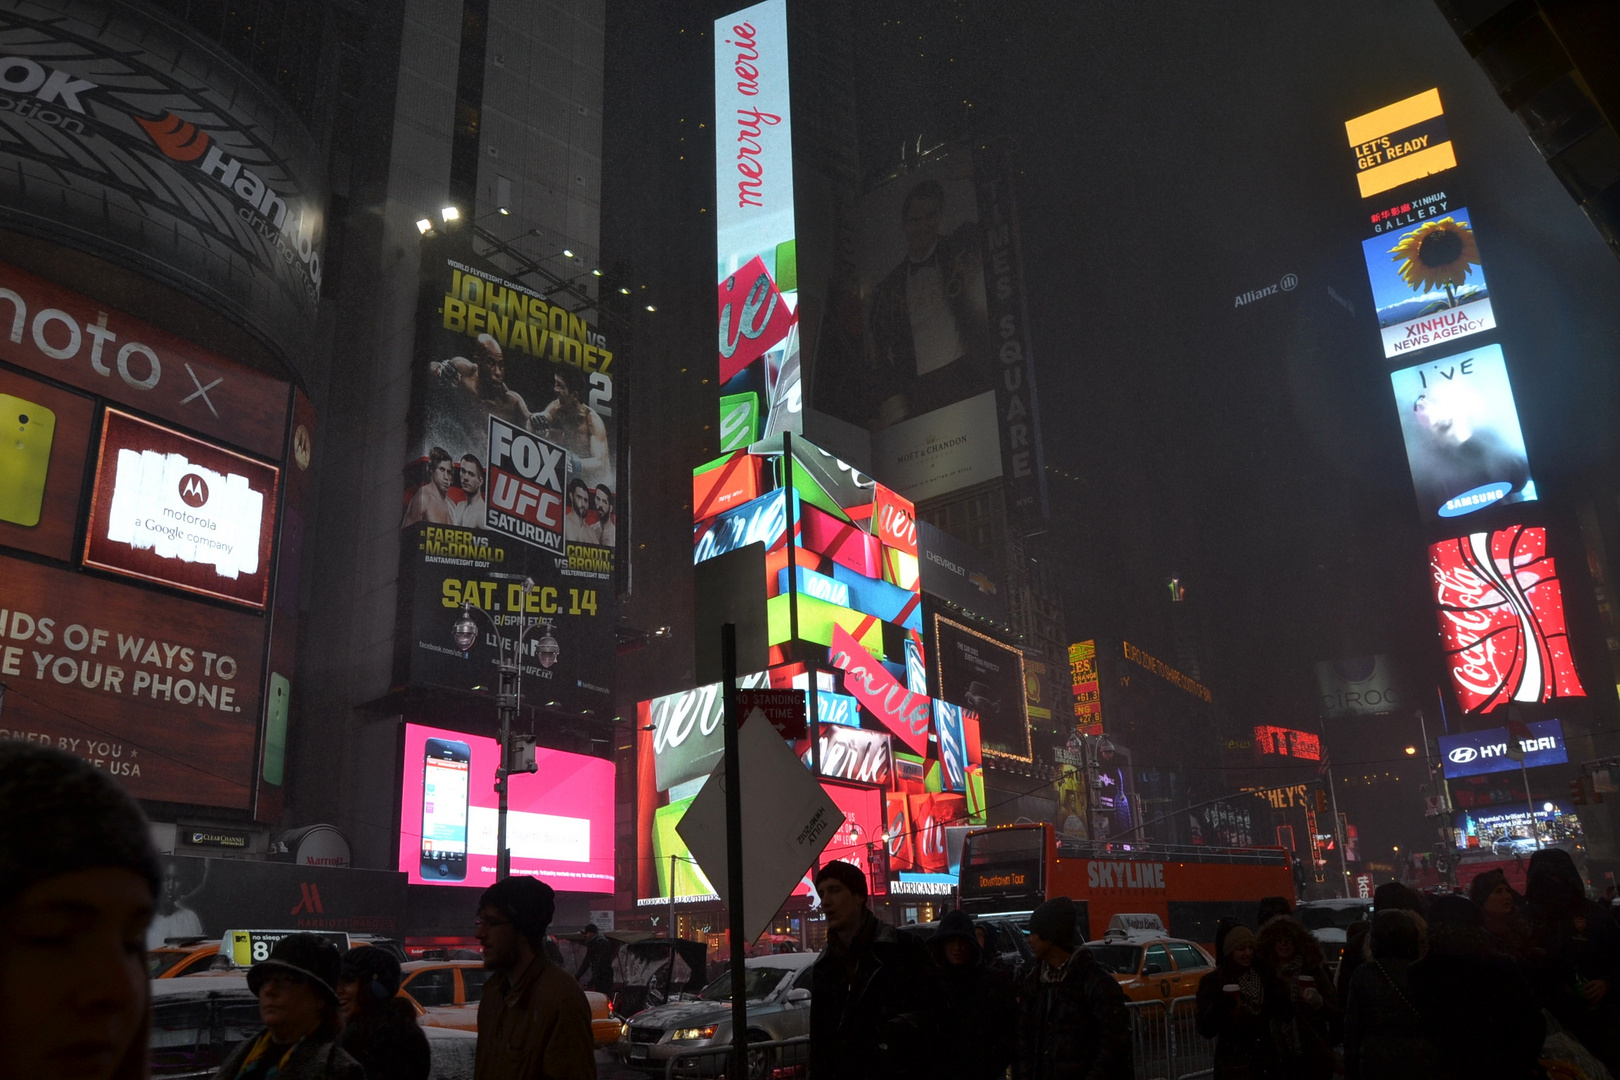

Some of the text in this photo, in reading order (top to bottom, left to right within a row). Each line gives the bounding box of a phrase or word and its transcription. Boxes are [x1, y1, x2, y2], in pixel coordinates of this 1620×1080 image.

[724, 22, 782, 208] merry aerie
[1355, 137, 1391, 158] LET'S
[1358, 135, 1429, 170] GET READY
[1412, 191, 1446, 209] XINHUA
[200, 146, 322, 302] Hankoo
[1374, 202, 1448, 233] GALLERY
[238, 207, 294, 265] driving
[447, 258, 547, 300] WORLD FLYWEIGHT CHAMPIONSHIP
[445, 268, 606, 350] JOHNSON VS
[1234, 284, 1279, 308] Allianz
[1394, 318, 1485, 352] NEWS AGENCY
[1405, 310, 1469, 338] XINHUA
[0, 287, 162, 392] oto
[442, 296, 614, 380] BENAVIDEZ
[589, 371, 613, 417] 2
[491, 419, 563, 493] FOX
[926, 435, 968, 455] CHANDON
[492, 473, 561, 527] UFC
[1446, 489, 1504, 510] SAMSUNG
[163, 505, 217, 532] motorola
[488, 508, 562, 549] SATURDAY
[135, 518, 234, 555] a Google company
[426, 526, 489, 547] FABER VS
[425, 541, 505, 563] McDONALD
[425, 556, 490, 568] BANTAMWEIGHT BOUT
[554, 556, 611, 573] VS BROWN
[566, 544, 611, 560] CONDIT
[926, 550, 966, 577] CHEVROLET
[442, 579, 598, 616] SAT. DEC. 14
[1431, 562, 1505, 696] Coca-Cola
[63, 624, 109, 656] OF
[117, 633, 195, 673] WAYS
[201, 651, 238, 681] TO
[31, 650, 125, 693] YOUR
[133, 672, 242, 713] PHONE.
[753, 693, 801, 705] STANDING
[58, 737, 80, 752] BY
[87, 739, 122, 758] YOU
[109, 761, 142, 778] USA
[892, 881, 931, 895] AMERICAN
[979, 873, 1025, 887] Downtown Tour
[1087, 862, 1166, 888] SKYLINE
[1357, 874, 1369, 899] tkts
[638, 898, 666, 906] AMERICAN
[262, 934, 281, 943] sleep
